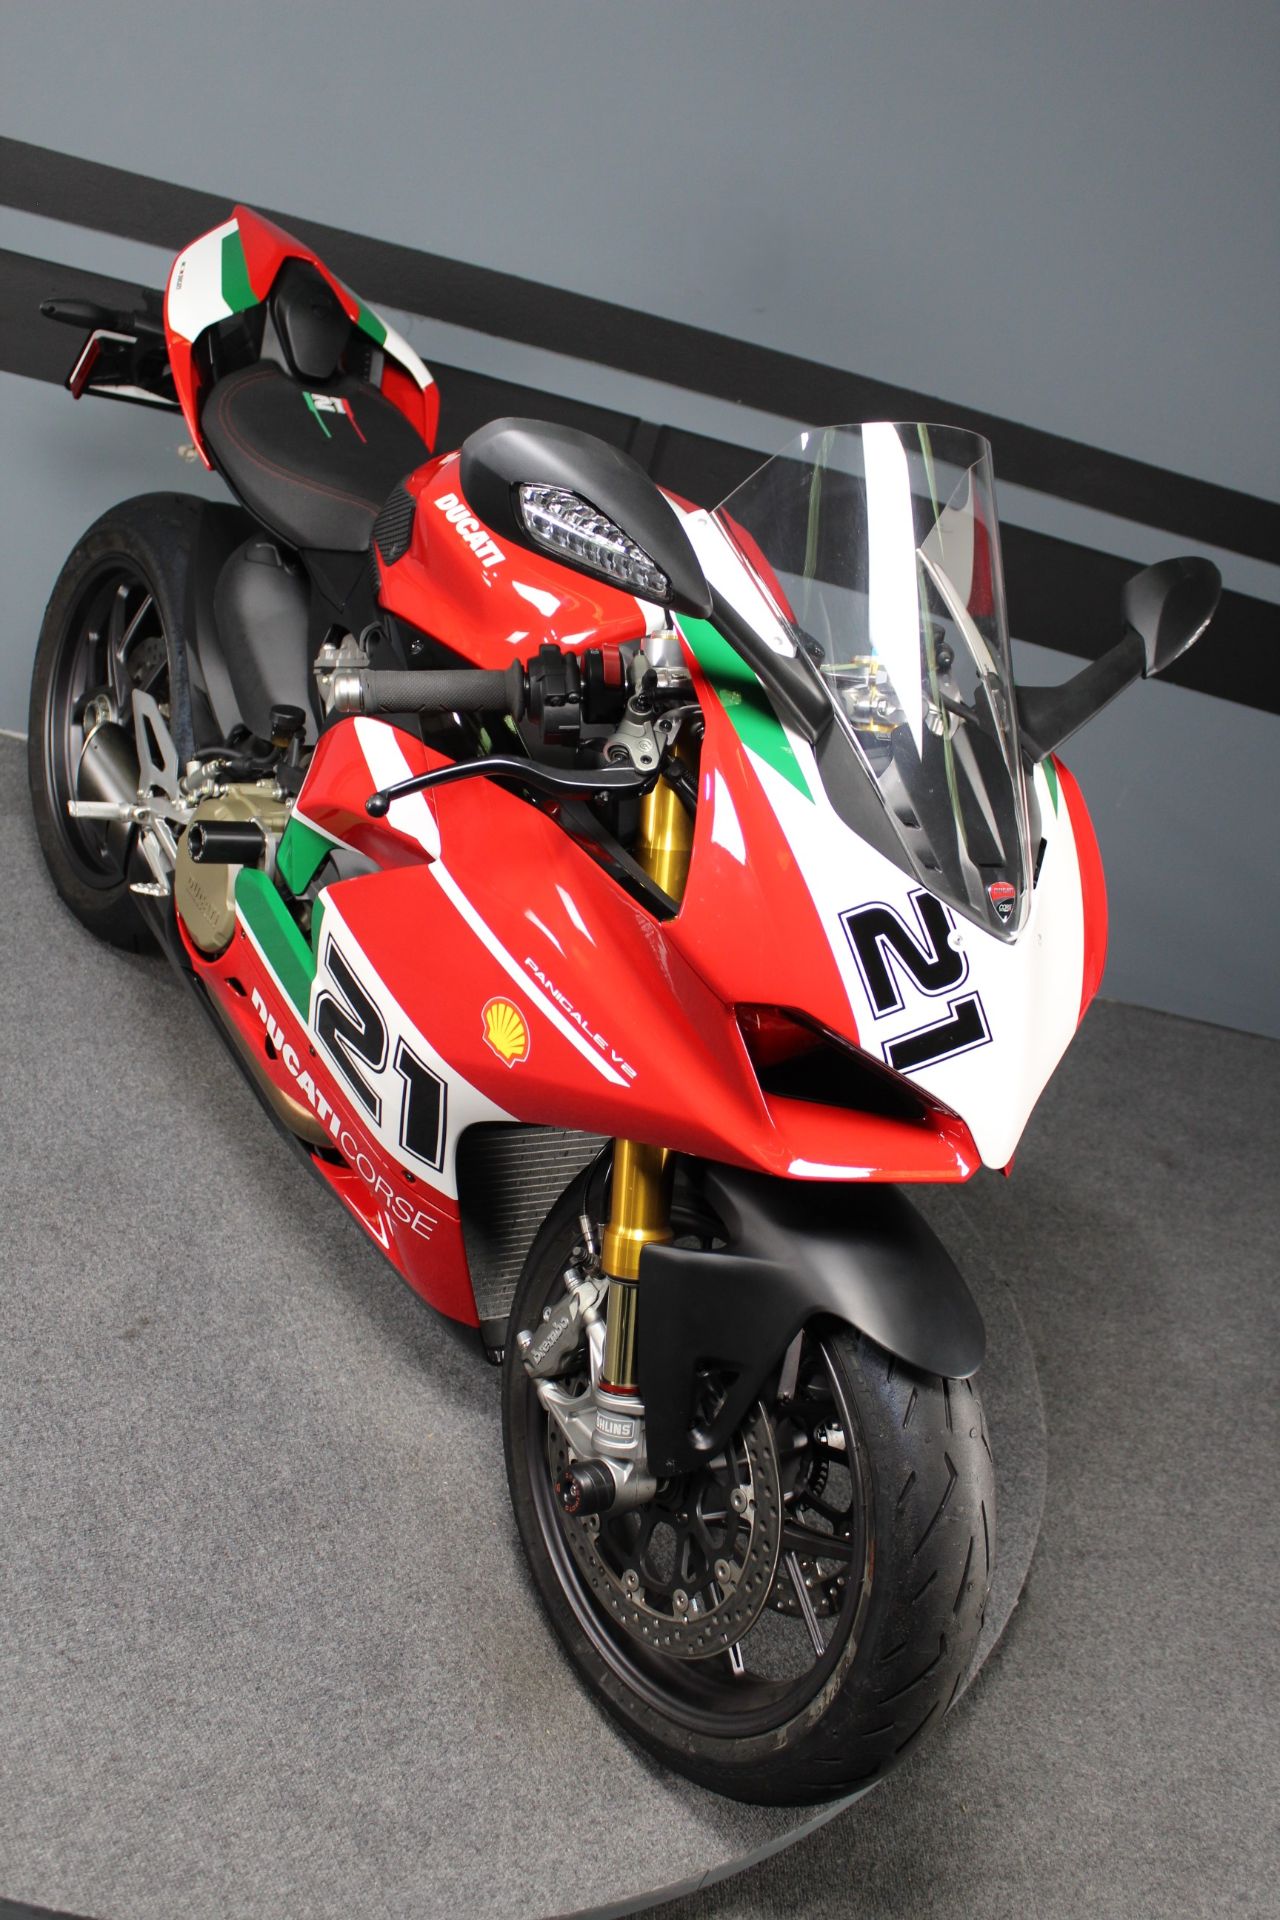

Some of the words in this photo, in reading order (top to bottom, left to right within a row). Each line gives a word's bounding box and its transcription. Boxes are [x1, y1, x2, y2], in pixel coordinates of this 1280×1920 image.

[434, 492, 506, 568] DUCATI
[524, 957, 609, 1050] PANIGALE
[611, 1048, 638, 1080] V2
[838, 887, 993, 1075] 21
[314, 931, 448, 1174] 21
[340, 1131, 438, 1241] CORSE
[596, 1415, 632, 1436] HLINS
